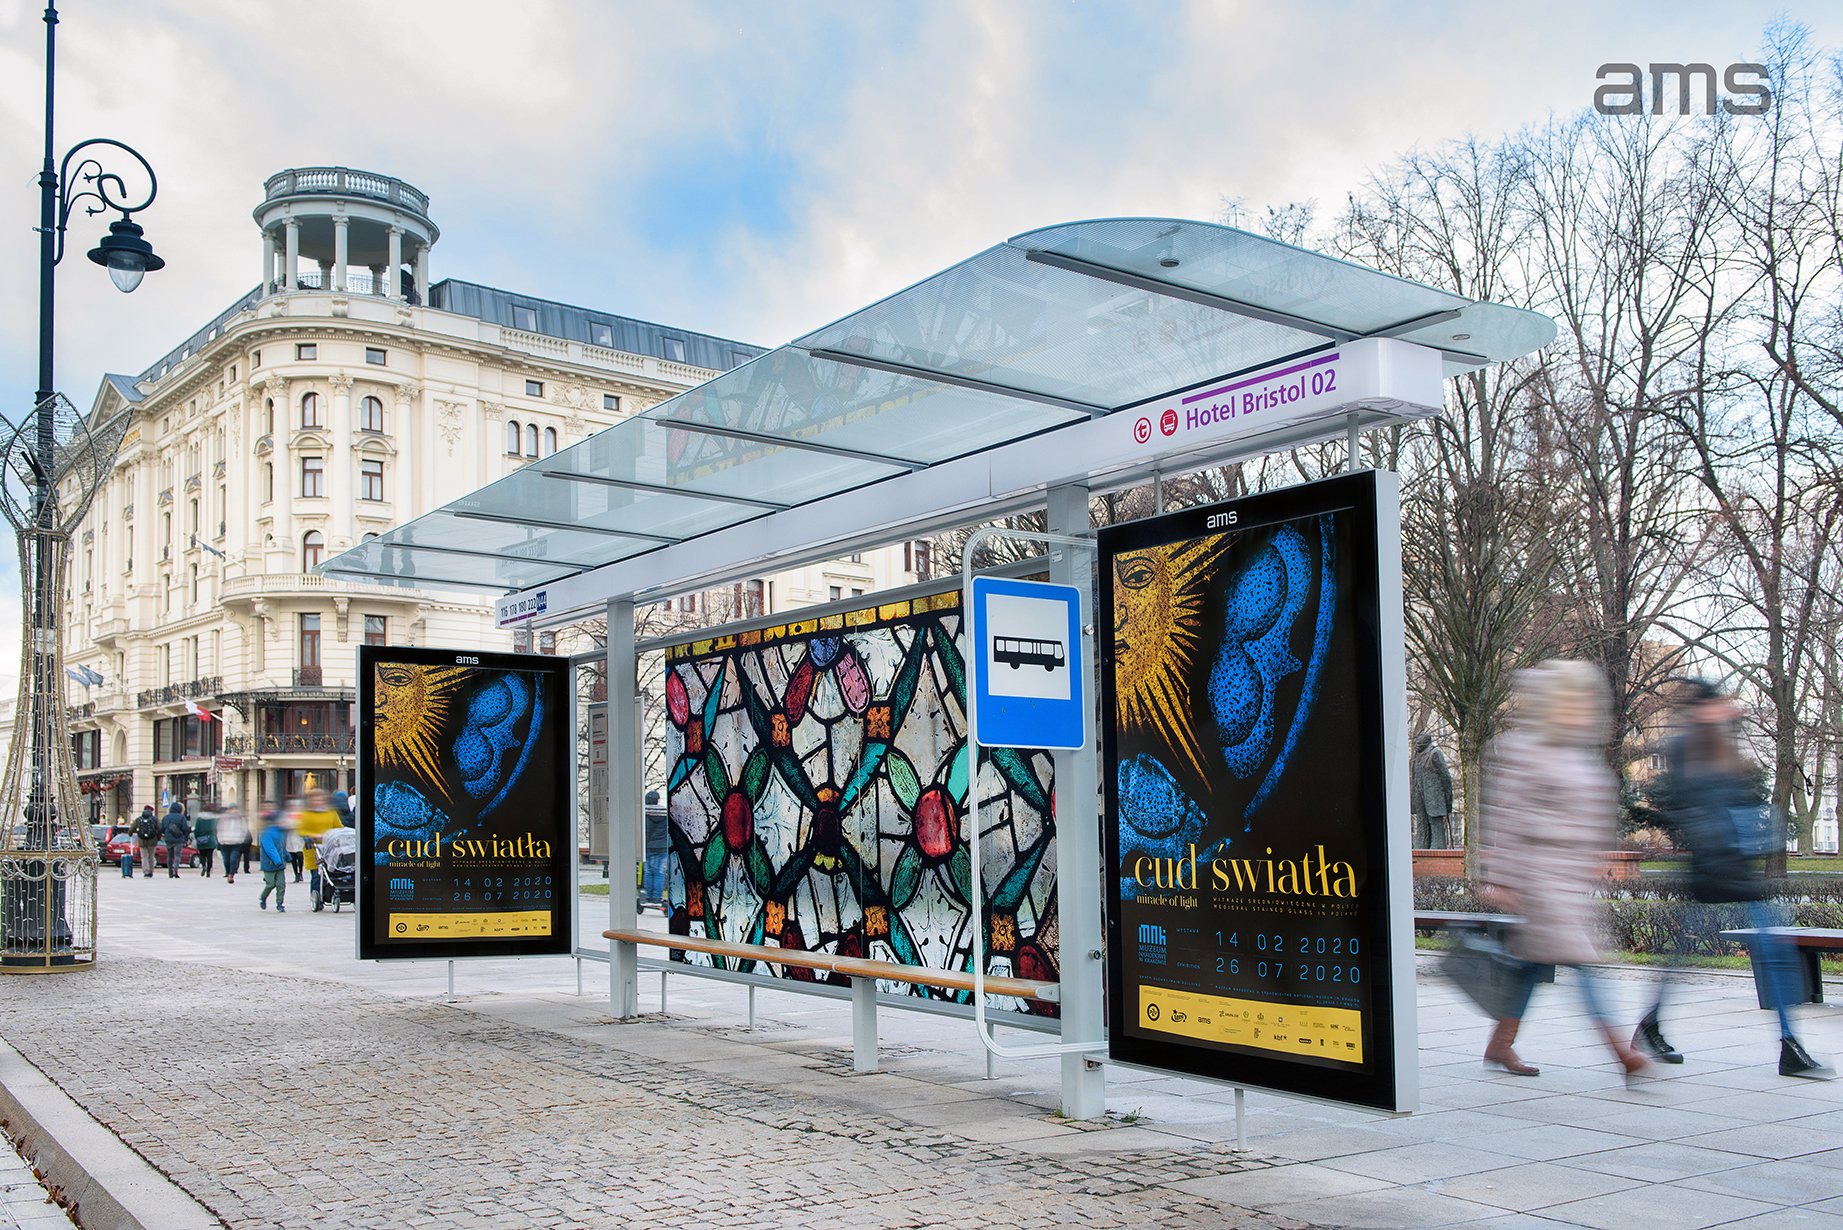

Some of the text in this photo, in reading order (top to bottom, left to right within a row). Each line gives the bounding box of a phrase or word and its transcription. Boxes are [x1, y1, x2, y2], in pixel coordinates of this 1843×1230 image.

[1186, 395, 1235, 431] Hotel
[1242, 375, 1305, 415] Bristol
[1311, 368, 1337, 394] 02
[1207, 510, 1238, 529] ams
[528, 598, 536, 610] 222
[455, 655, 479, 665] ams
[387, 832, 552, 859] cud światła
[389, 860, 441, 869] miracle of light
[1134, 843, 1360, 898] cud światła
[453, 876, 552, 888] 14 02 2020
[453, 889, 552, 901] 26 07 2020
[1136, 893, 1198, 911] miracle of light
[1213, 904, 1249, 912] MEDIEVAL
[1288, 908, 1313, 916] GLASS
[1138, 944, 1167, 954] MUZEUM
[1215, 930, 1359, 955] 14 02 2020
[1215, 957, 1360, 984] 26 07 2020
